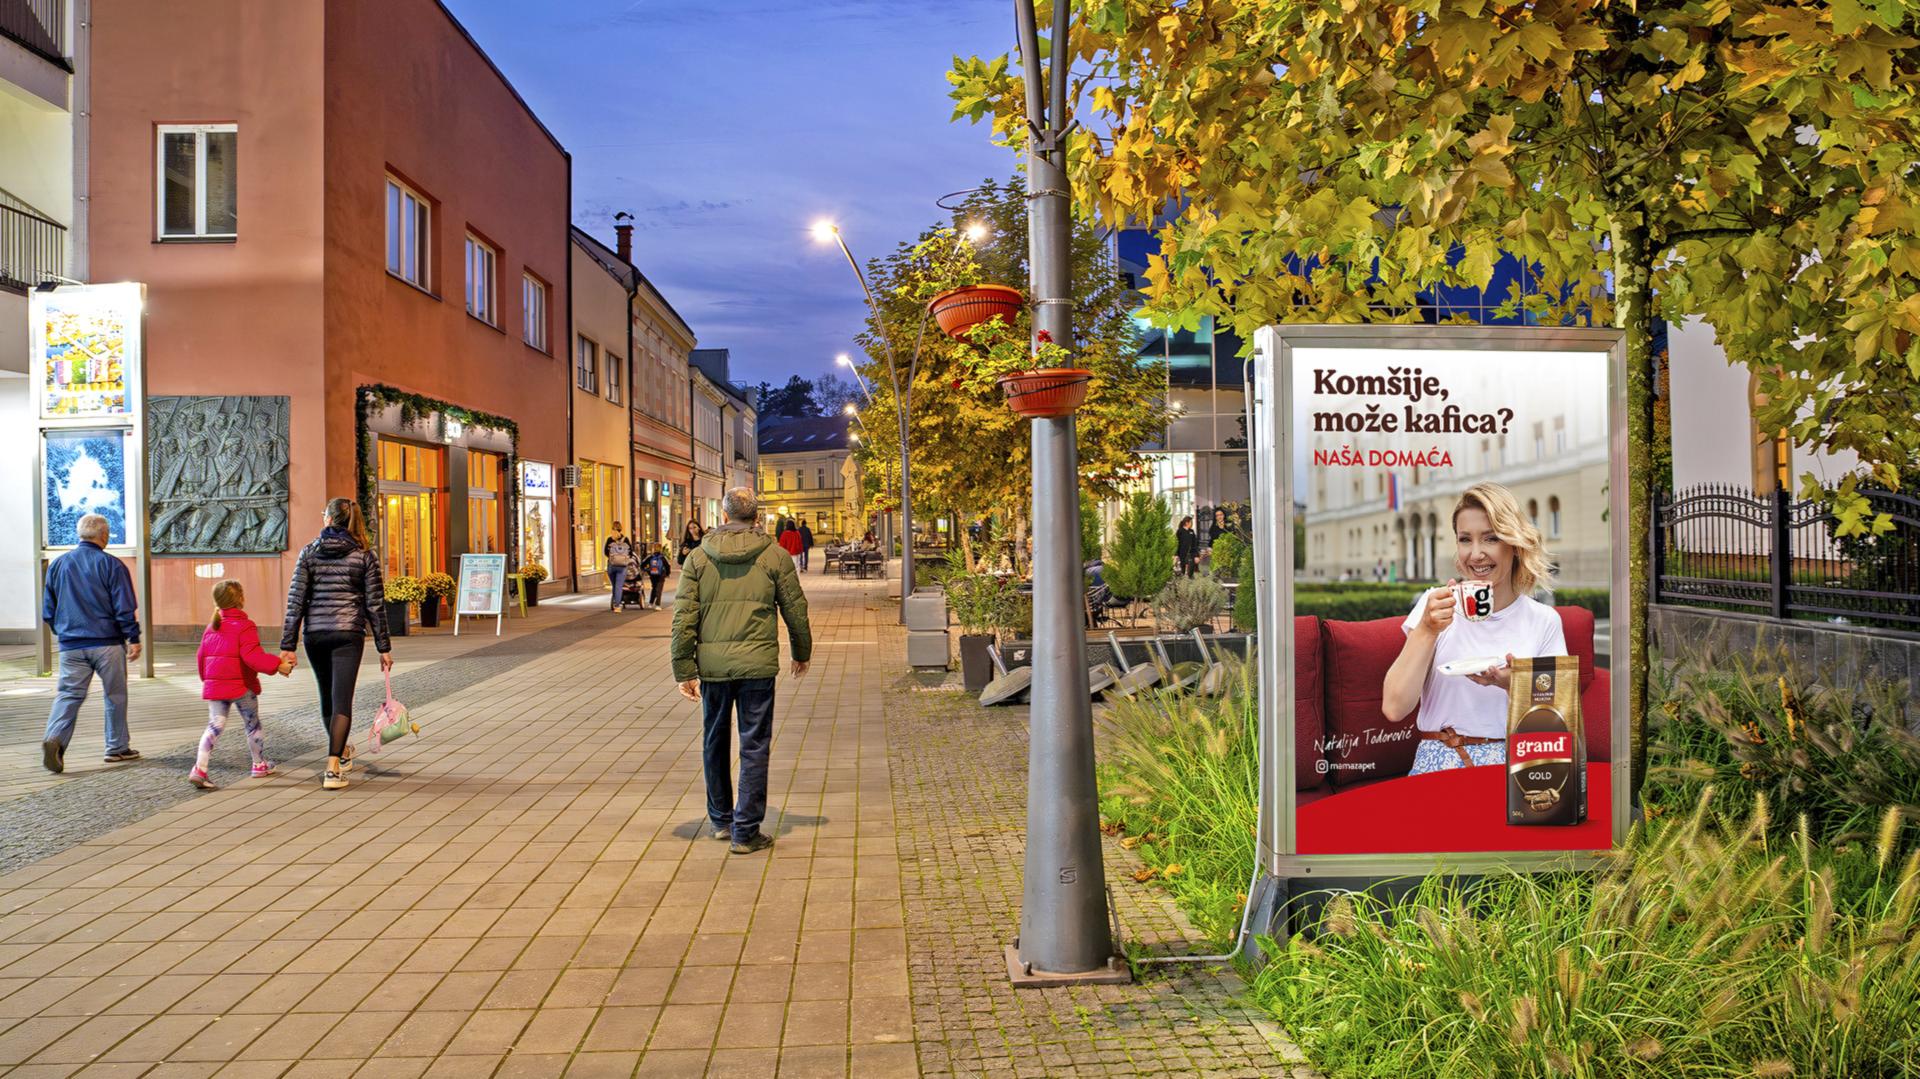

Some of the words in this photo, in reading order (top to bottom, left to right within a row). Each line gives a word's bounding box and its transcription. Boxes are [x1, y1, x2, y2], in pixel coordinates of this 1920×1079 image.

[1313, 366, 1449, 402] Komšije,
[1313, 403, 1398, 433] može
[1404, 404, 1514, 434] kafica?
[1313, 445, 1364, 467] NAŠA
[1369, 446, 1454, 468] DOMAĆA
[1314, 733, 1360, 758] Natalija
[1362, 724, 1415, 745] Todorović
[1516, 736, 1564, 757] grand
[1330, 762, 1376, 773] mamazapet
[1528, 771, 1553, 781] GOLD
